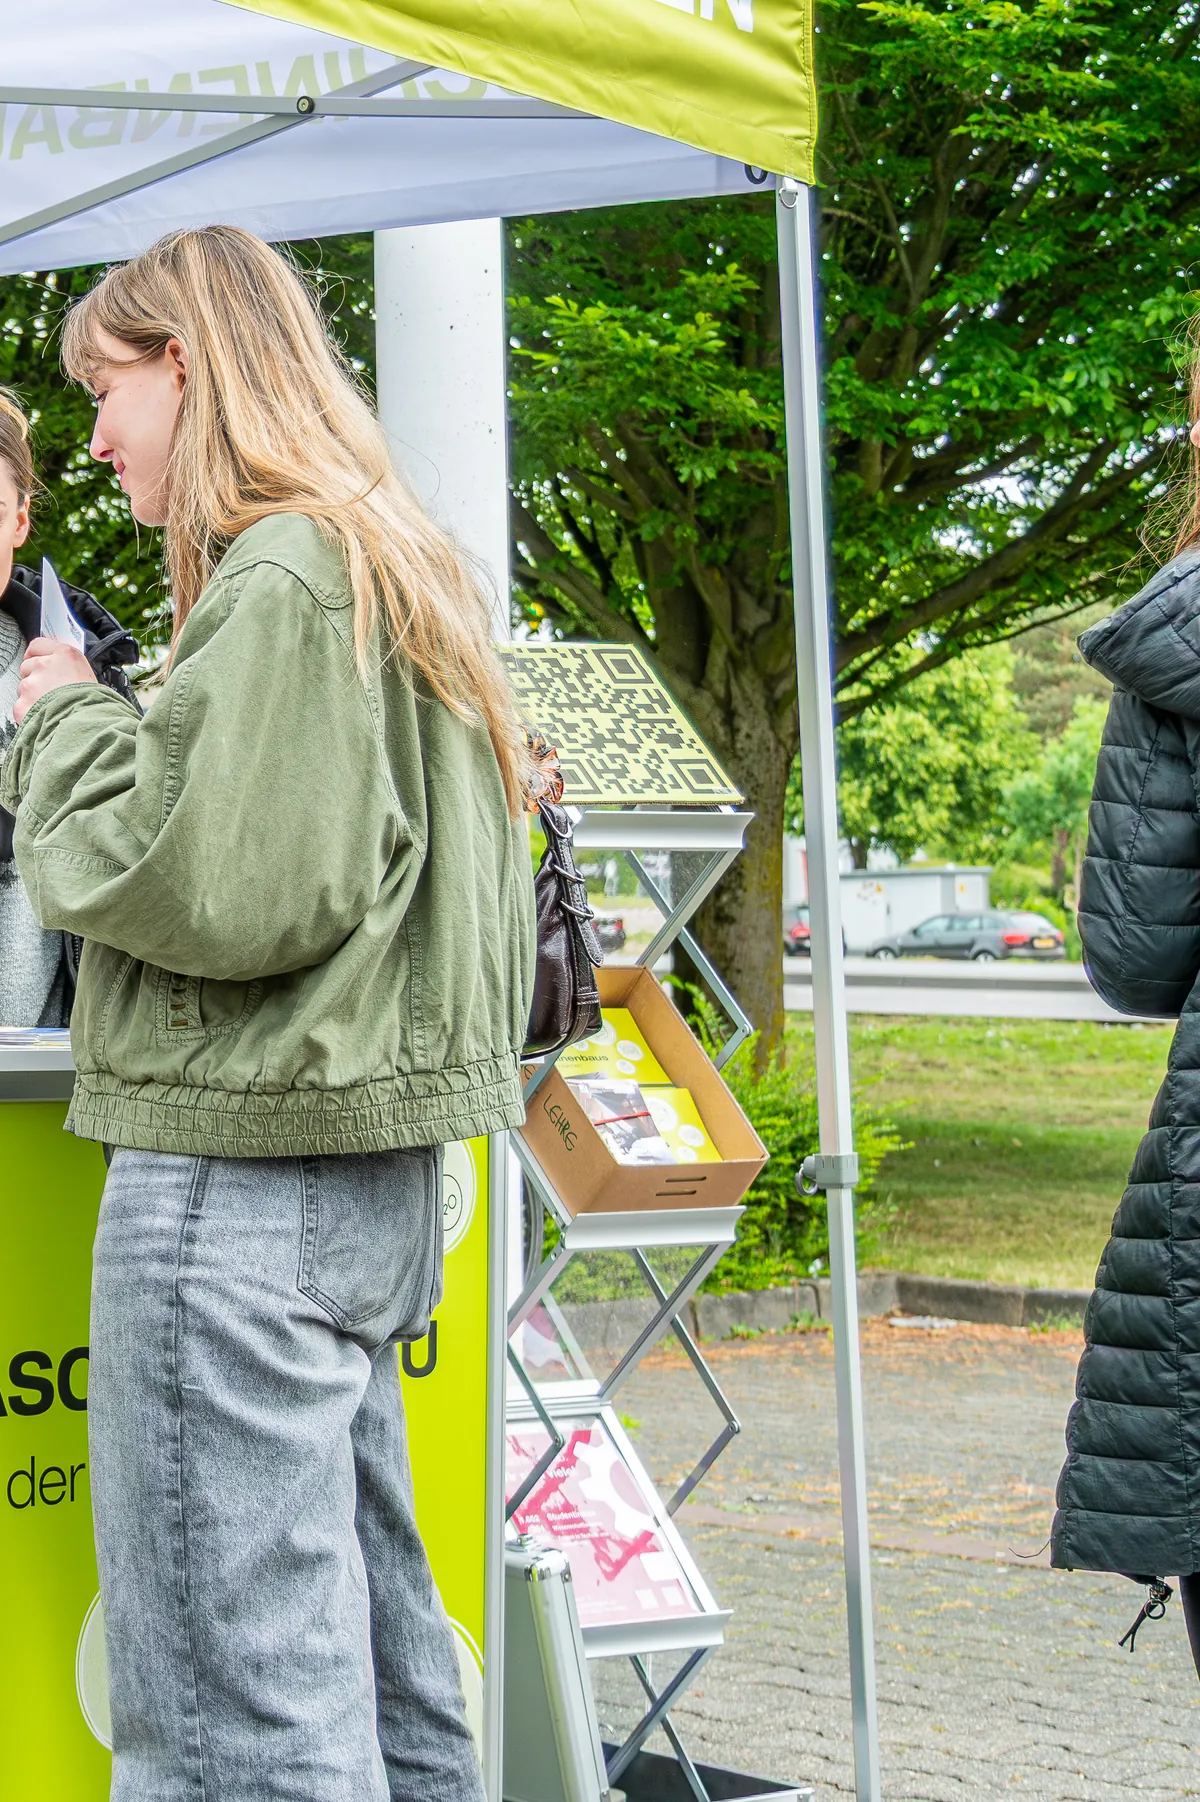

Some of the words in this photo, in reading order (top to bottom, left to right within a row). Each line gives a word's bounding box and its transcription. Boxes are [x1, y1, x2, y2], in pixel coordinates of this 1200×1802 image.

[557, 1054, 609, 1062] inenbaus
[543, 1094, 577, 1151] LEHRE
[443, 1194, 457, 1215] 2O
[6, 1455, 87, 1510] der
